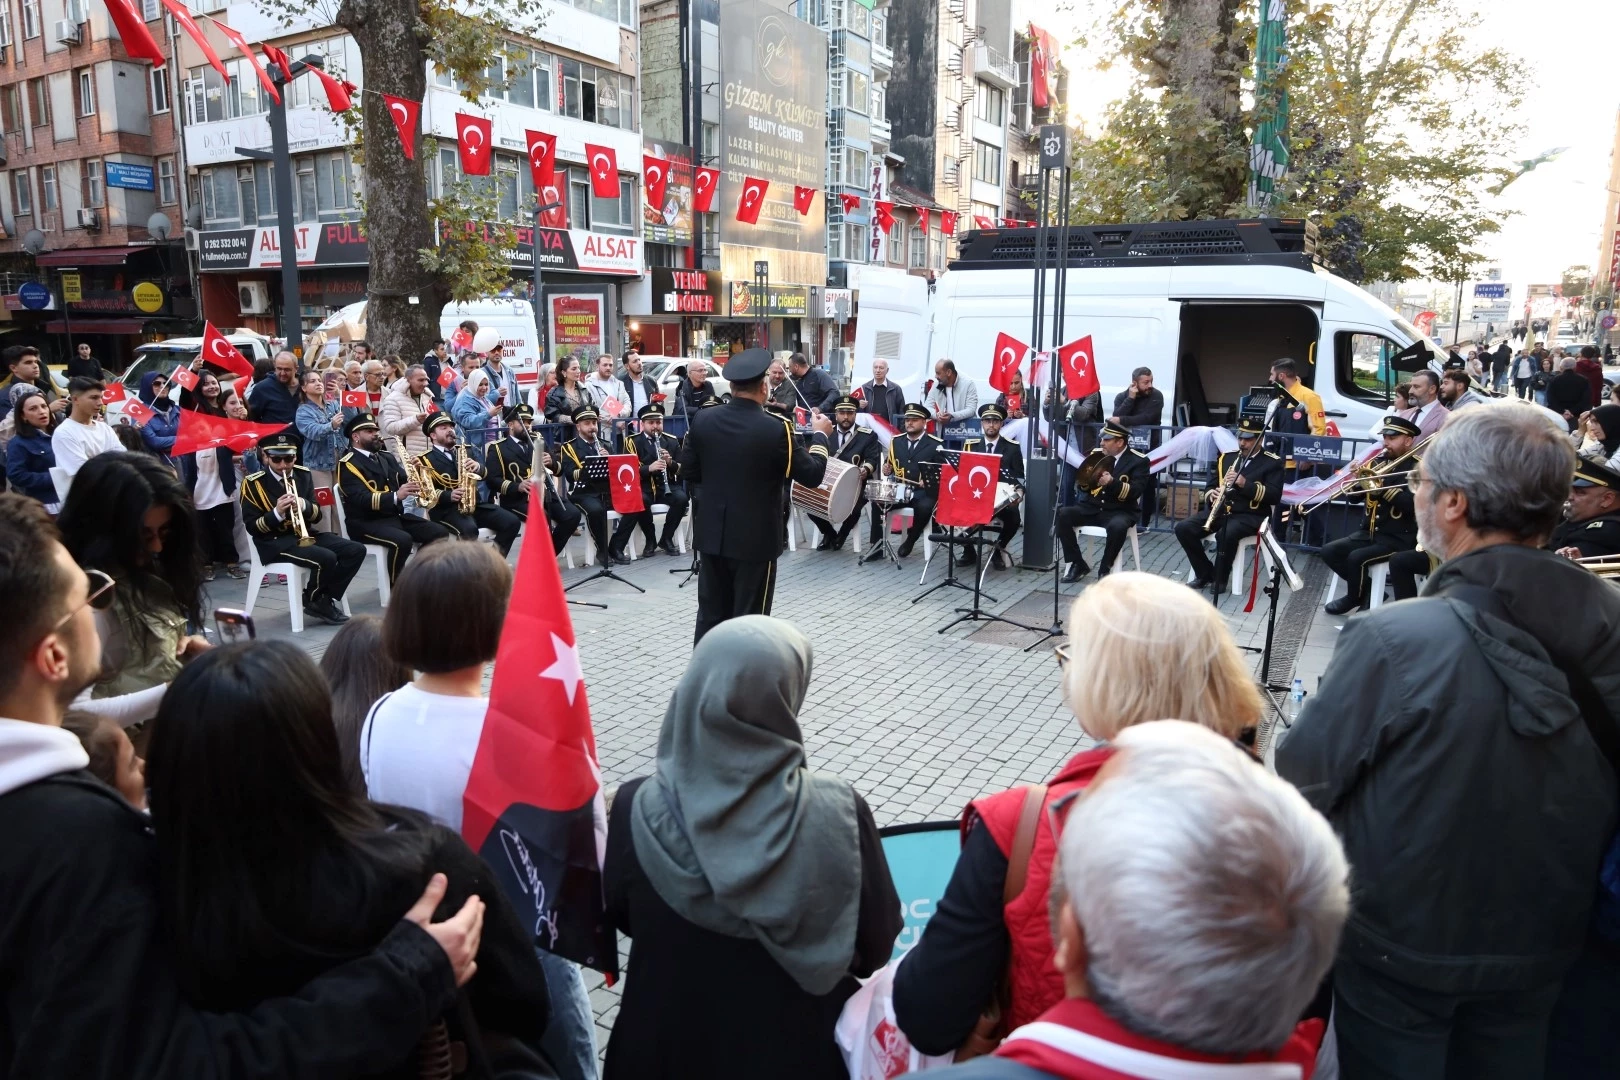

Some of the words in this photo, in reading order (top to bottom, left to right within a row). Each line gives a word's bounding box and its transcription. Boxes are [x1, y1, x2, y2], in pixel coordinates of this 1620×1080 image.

[724, 80, 774, 115] GİZEM
[775, 97, 823, 130] KÜMET
[748, 115, 776, 135] BEAUTY
[777, 124, 804, 143] CENTER
[728, 135, 753, 152] LAZER
[755, 142, 793, 162] EPİLASYON
[728, 153, 749, 167] KALICI
[750, 158, 774, 173] MAKYAJ
[772, 204, 786, 218] 499
[204, 241, 209, 249] 0
[209, 240, 220, 249] 262
[220, 239, 231, 248] 332
[231, 238, 239, 247] 00
[239, 238, 247, 247] 41
[583, 235, 637, 259] ALSAT
[205, 251, 248, 262] fullmedya.com.tr
[671, 271, 708, 291] YENİR
[770, 292, 777, 308] Bİ
[777, 293, 806, 310] ÇİĞKÖFTE
